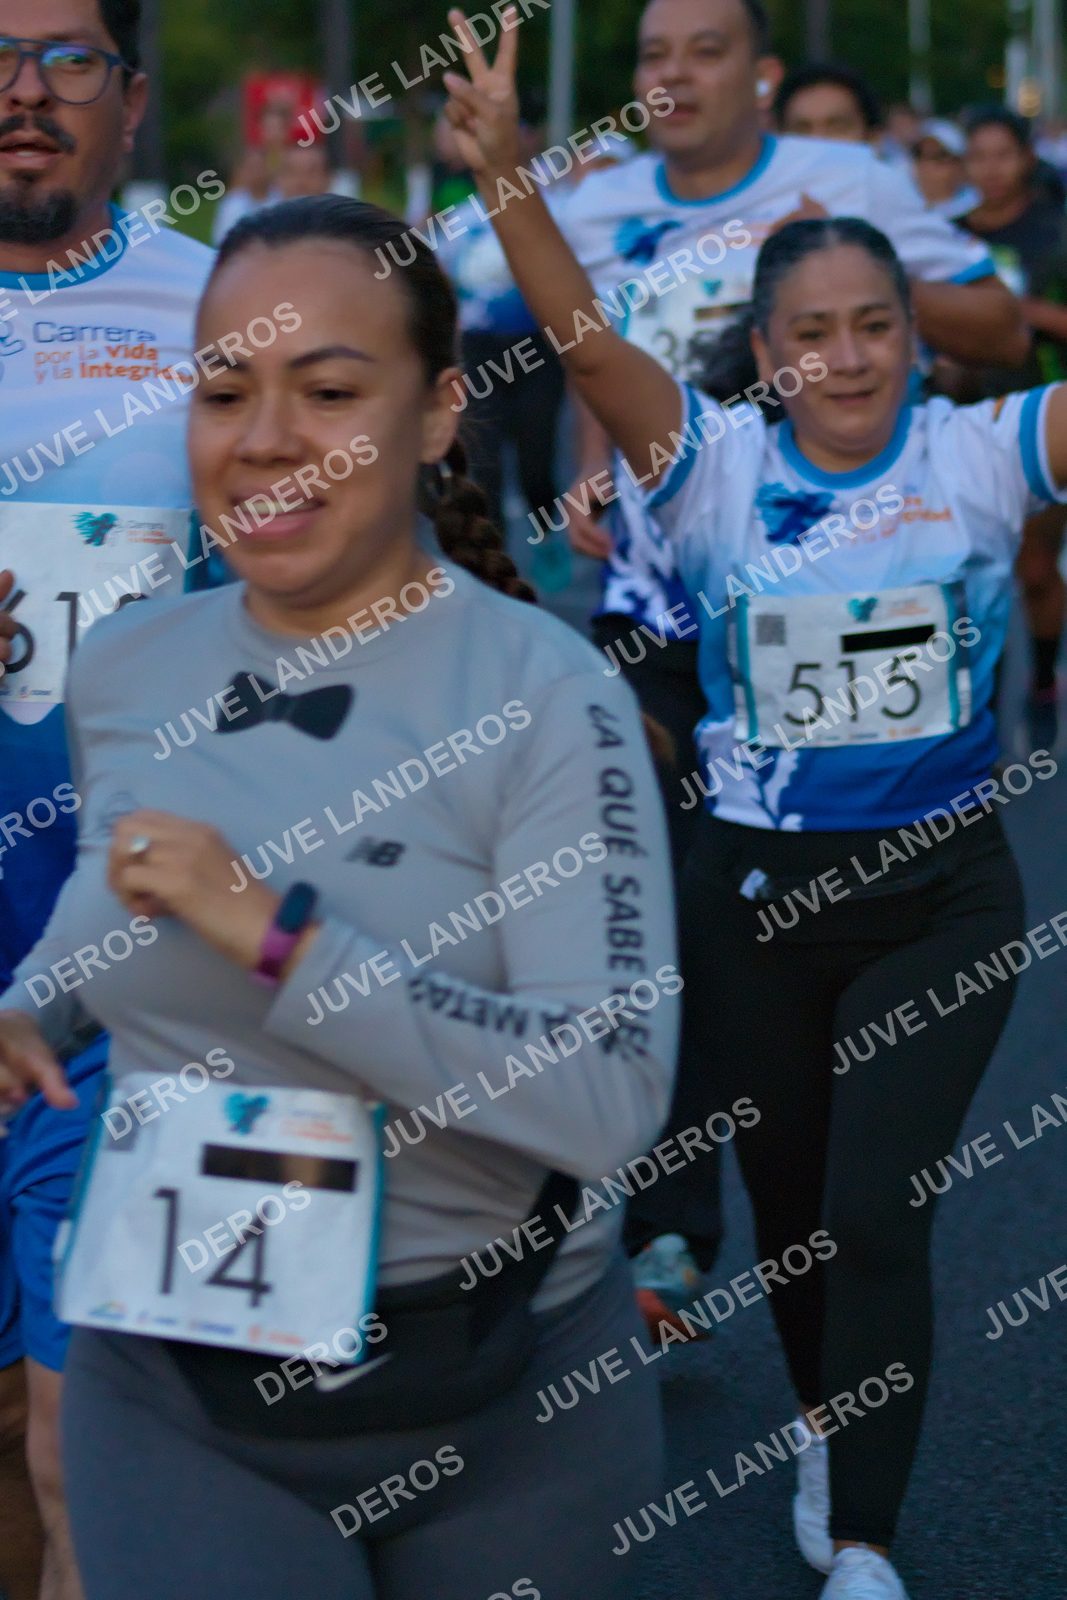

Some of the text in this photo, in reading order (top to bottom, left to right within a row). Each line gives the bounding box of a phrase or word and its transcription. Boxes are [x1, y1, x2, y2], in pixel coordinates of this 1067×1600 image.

[32, 321, 157, 343] Carrera
[34, 350, 72, 368] por
[79, 344, 98, 360] la
[35, 369, 47, 384] y
[53, 364, 73, 379] la
[2, 588, 149, 674] 61
[783, 653, 922, 726] 515
[598, 767, 648, 858] QUÉ
[602, 873, 646, 973] SABE
[154, 1187, 272, 1308] 14
